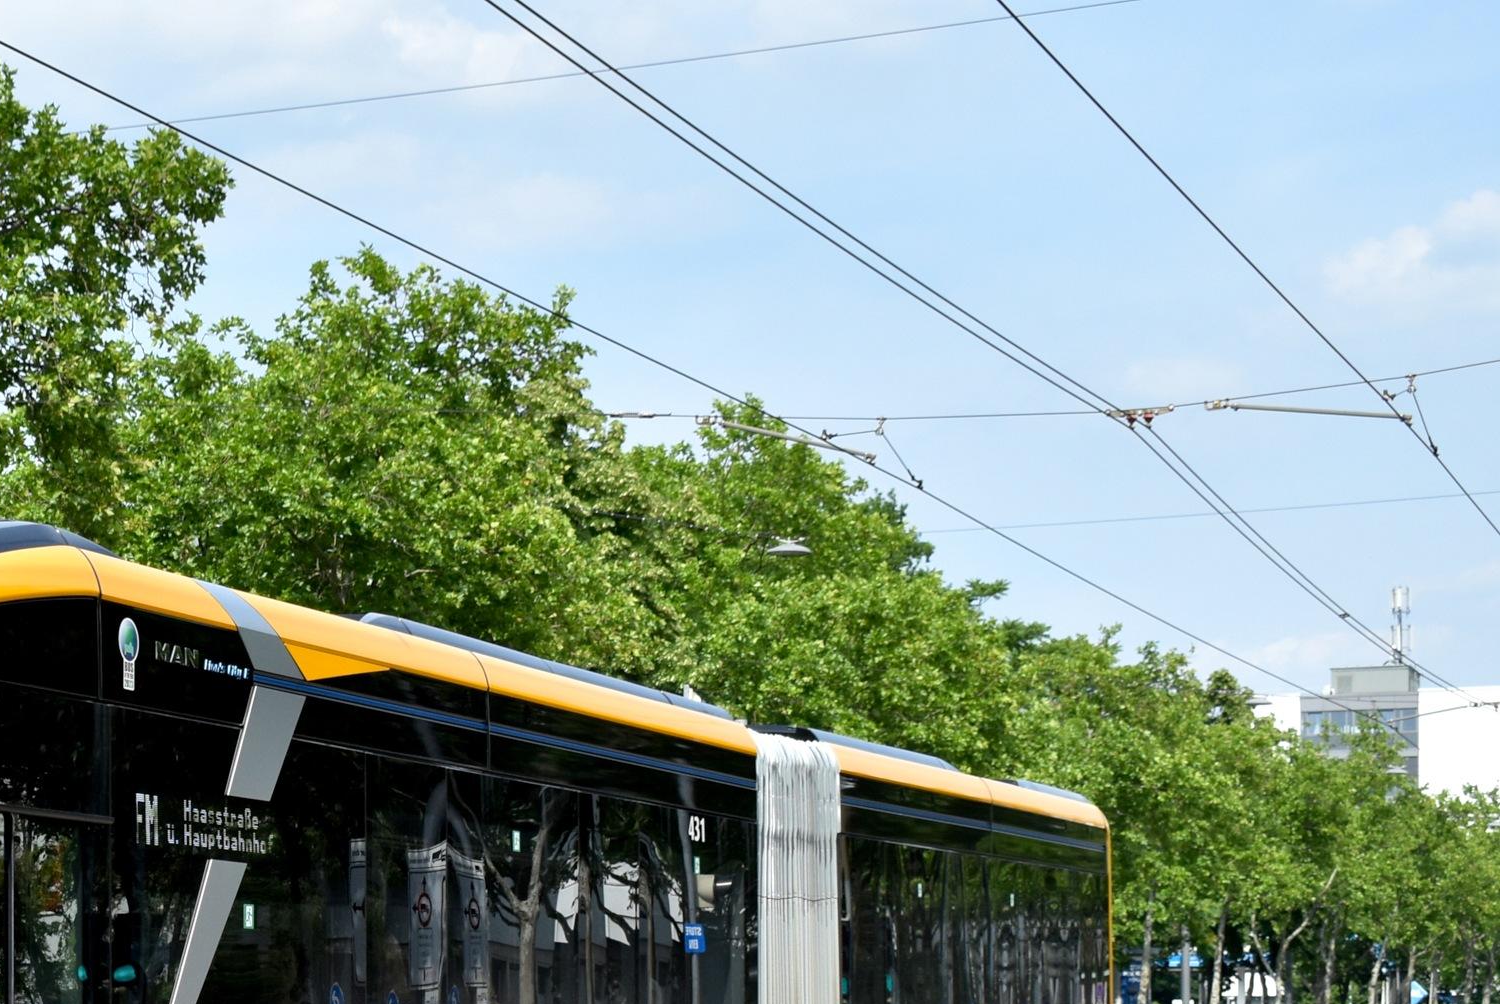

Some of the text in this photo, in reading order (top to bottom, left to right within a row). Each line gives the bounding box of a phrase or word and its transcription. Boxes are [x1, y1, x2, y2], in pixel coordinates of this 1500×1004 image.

[155, 640, 199, 668] MAN
[136, 792, 159, 846] FM
[183, 799, 259, 830] Haasstraße
[688, 815, 706, 843] 431
[166, 823, 276, 855] ü. Hauptbahnhof
